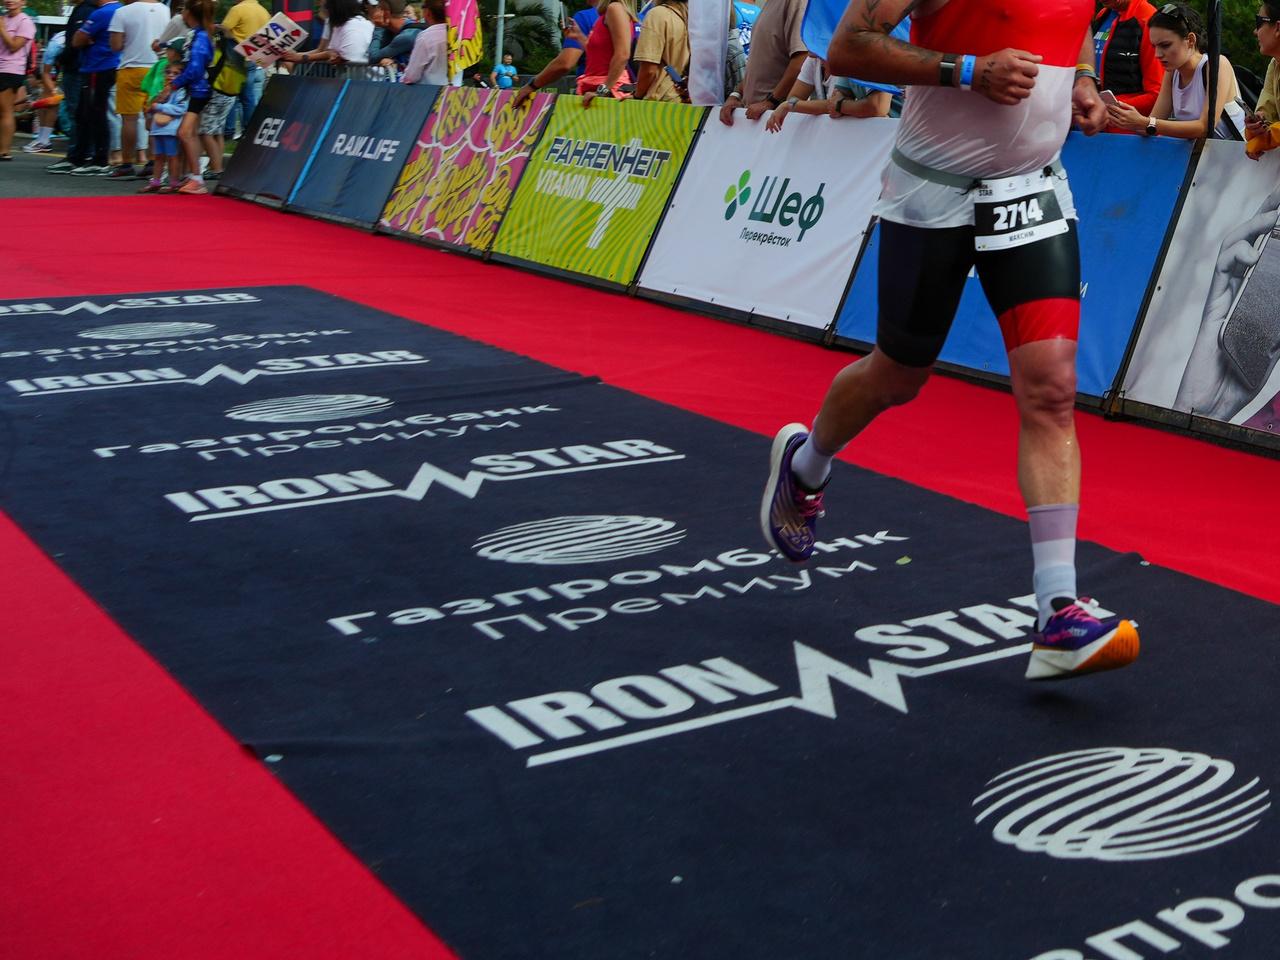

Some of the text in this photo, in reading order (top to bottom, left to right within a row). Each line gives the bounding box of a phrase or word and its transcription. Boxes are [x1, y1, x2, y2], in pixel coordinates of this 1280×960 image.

[543, 136, 672, 180] FAHRENHEIT
[536, 168, 591, 201] VITAMIN
[748, 175, 826, 242] Шеф
[993, 198, 1044, 231] 2714
[739, 227, 792, 247] Перекрёсток
[117, 292, 258, 306] STAR
[4, 350, 425, 394] IRON STAR
[93, 404, 561, 458] Газпромбанк
[197, 420, 521, 461] Премиум
[164, 439, 676, 514] IRON STAR
[326, 529, 910, 636] Газпромбнк
[472, 560, 878, 640] Премиум
[466, 656, 779, 750] IRON
